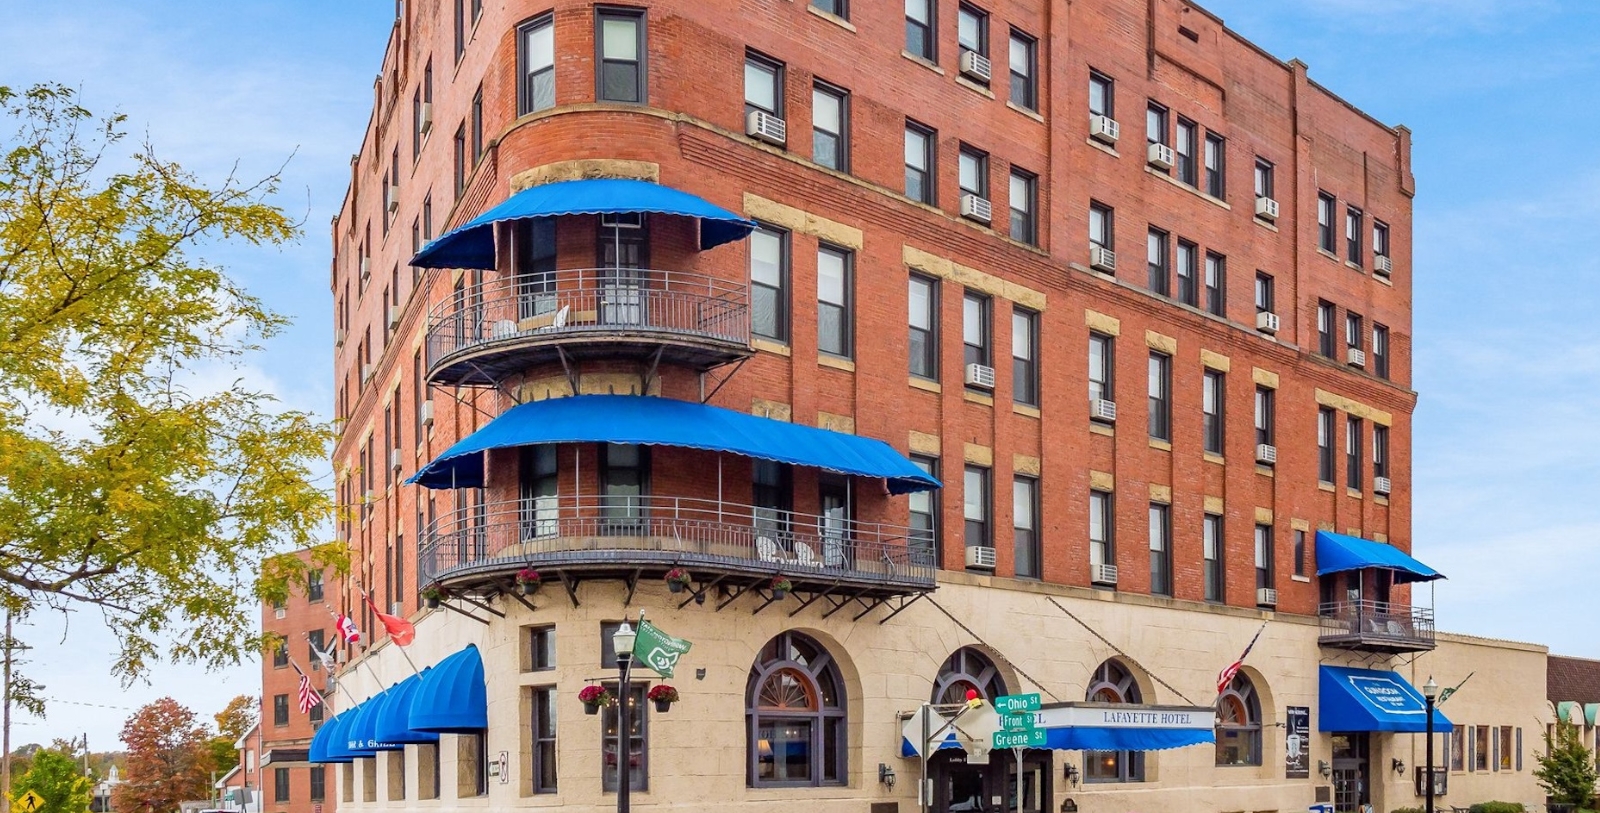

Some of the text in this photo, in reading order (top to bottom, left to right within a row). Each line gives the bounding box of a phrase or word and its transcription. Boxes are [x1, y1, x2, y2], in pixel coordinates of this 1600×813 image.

[1007, 696, 1038, 710] Ohio St
[1004, 715, 1023, 727] Front
[1026, 715, 1033, 724] St
[1103, 711, 1192, 724] LAFAYETTE HOTEL
[996, 731, 1043, 746] Greene St
